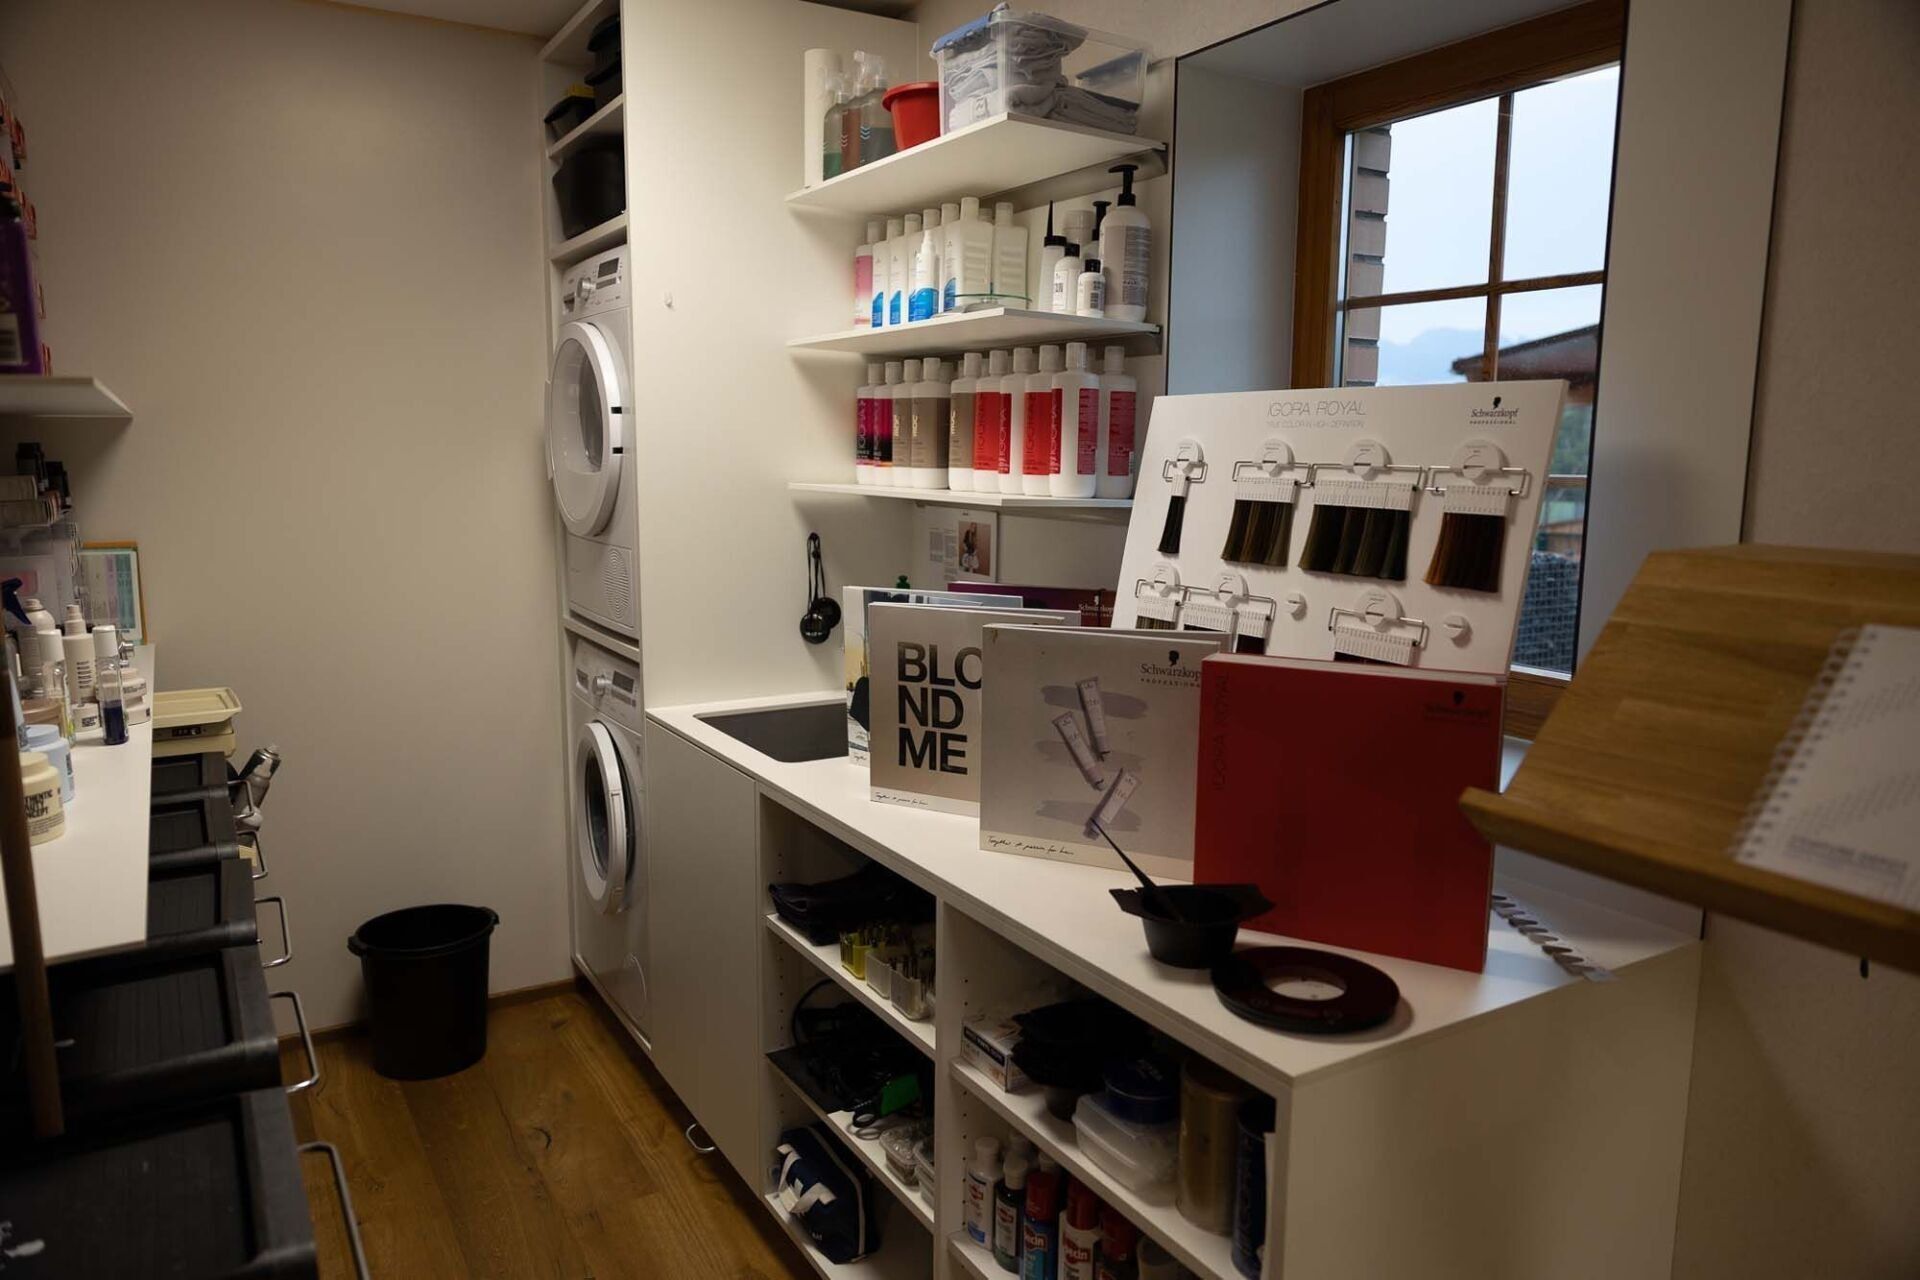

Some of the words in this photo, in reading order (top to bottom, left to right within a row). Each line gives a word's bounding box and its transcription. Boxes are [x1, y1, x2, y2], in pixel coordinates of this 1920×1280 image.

[1266, 400, 1311, 417] IGORA
[1315, 399, 1367, 416] ROYAL
[1471, 407, 1519, 420] Schwarzkopf
[1140, 663, 1201, 682] Schwarzkop
[1140, 678, 1201, 688] PROFESSIONA
[898, 685, 964, 731] ND
[898, 727, 969, 775] ME
